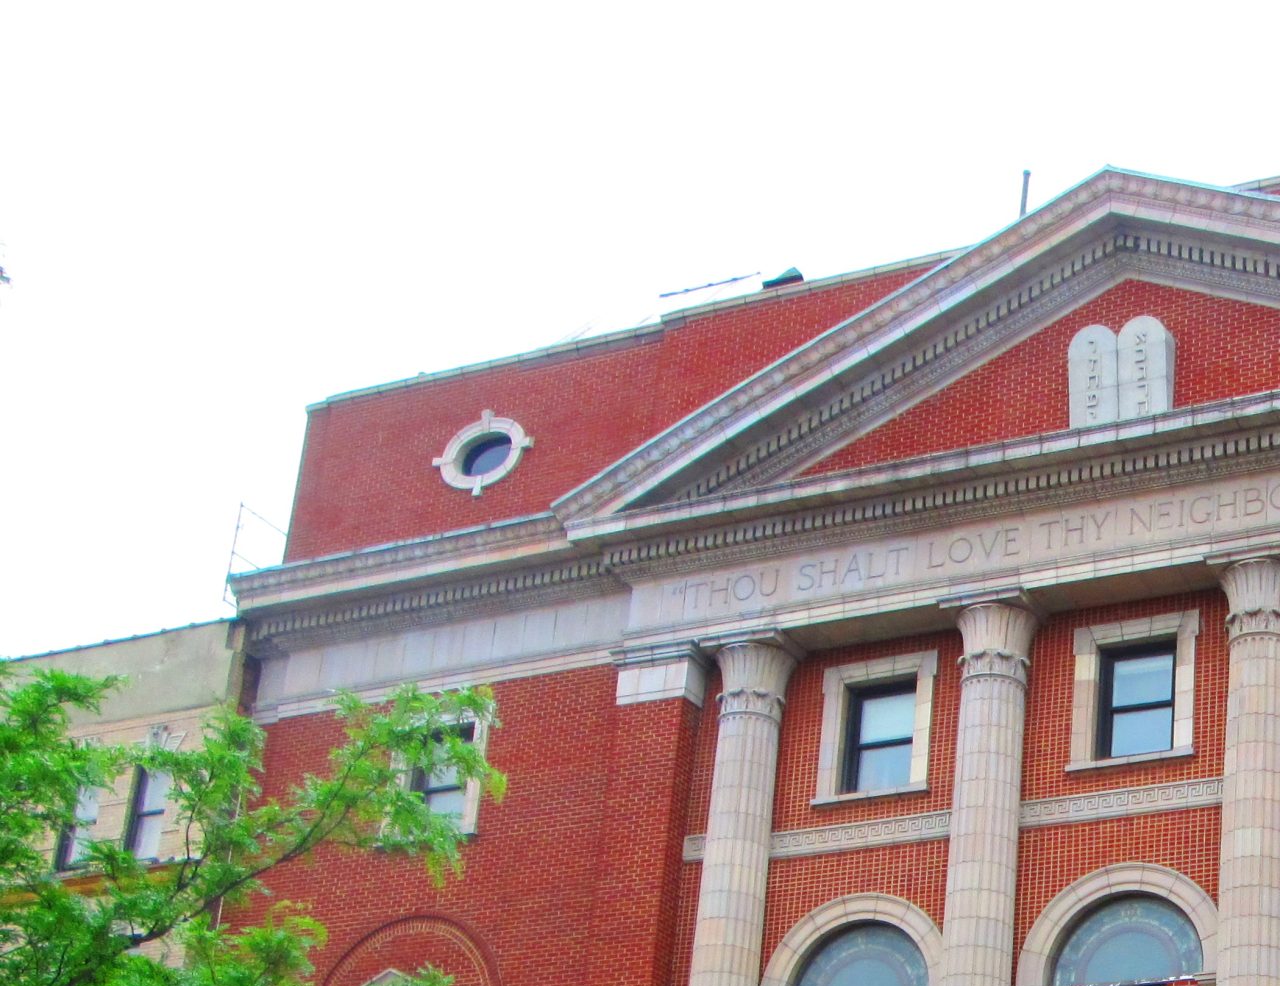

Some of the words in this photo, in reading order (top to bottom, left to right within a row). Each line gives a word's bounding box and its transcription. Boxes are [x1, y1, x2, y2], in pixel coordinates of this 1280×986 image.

[796, 546, 910, 592] SHALT
[926, 526, 1031, 570] LOVE
[1038, 510, 1113, 551] THY
